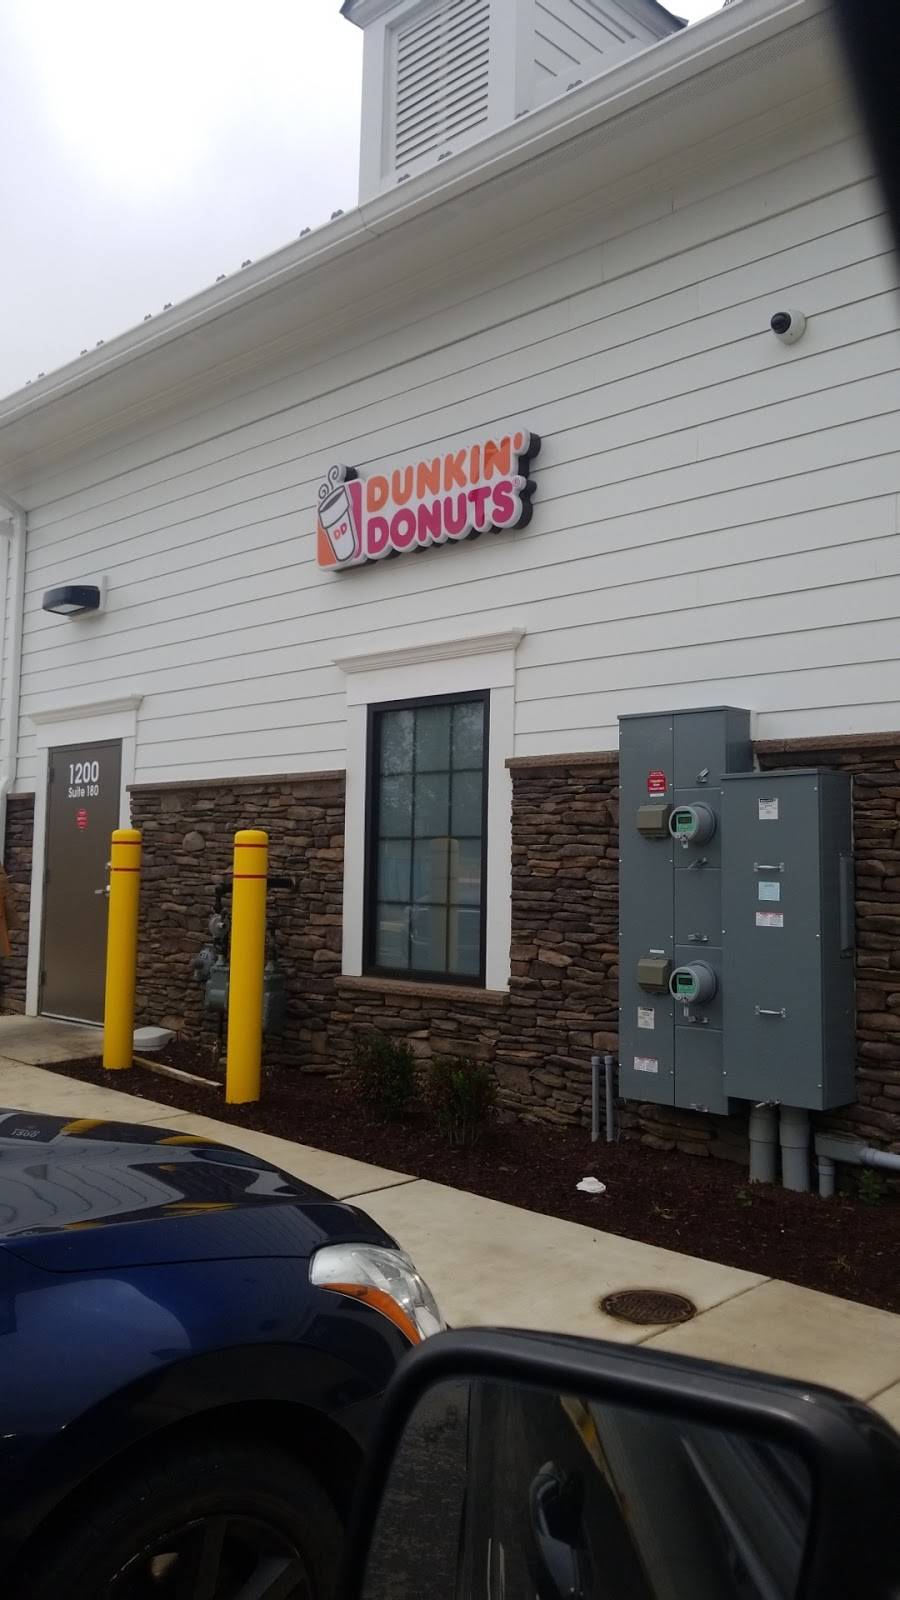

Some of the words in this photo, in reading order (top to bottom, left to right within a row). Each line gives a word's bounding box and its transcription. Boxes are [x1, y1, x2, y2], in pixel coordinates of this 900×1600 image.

[367, 431, 524, 512] DUNKIN'
[333, 522, 348, 540] DD
[69, 760, 99, 784] 1200
[68, 786, 85, 798] Suite
[87, 784, 99, 796] 180
